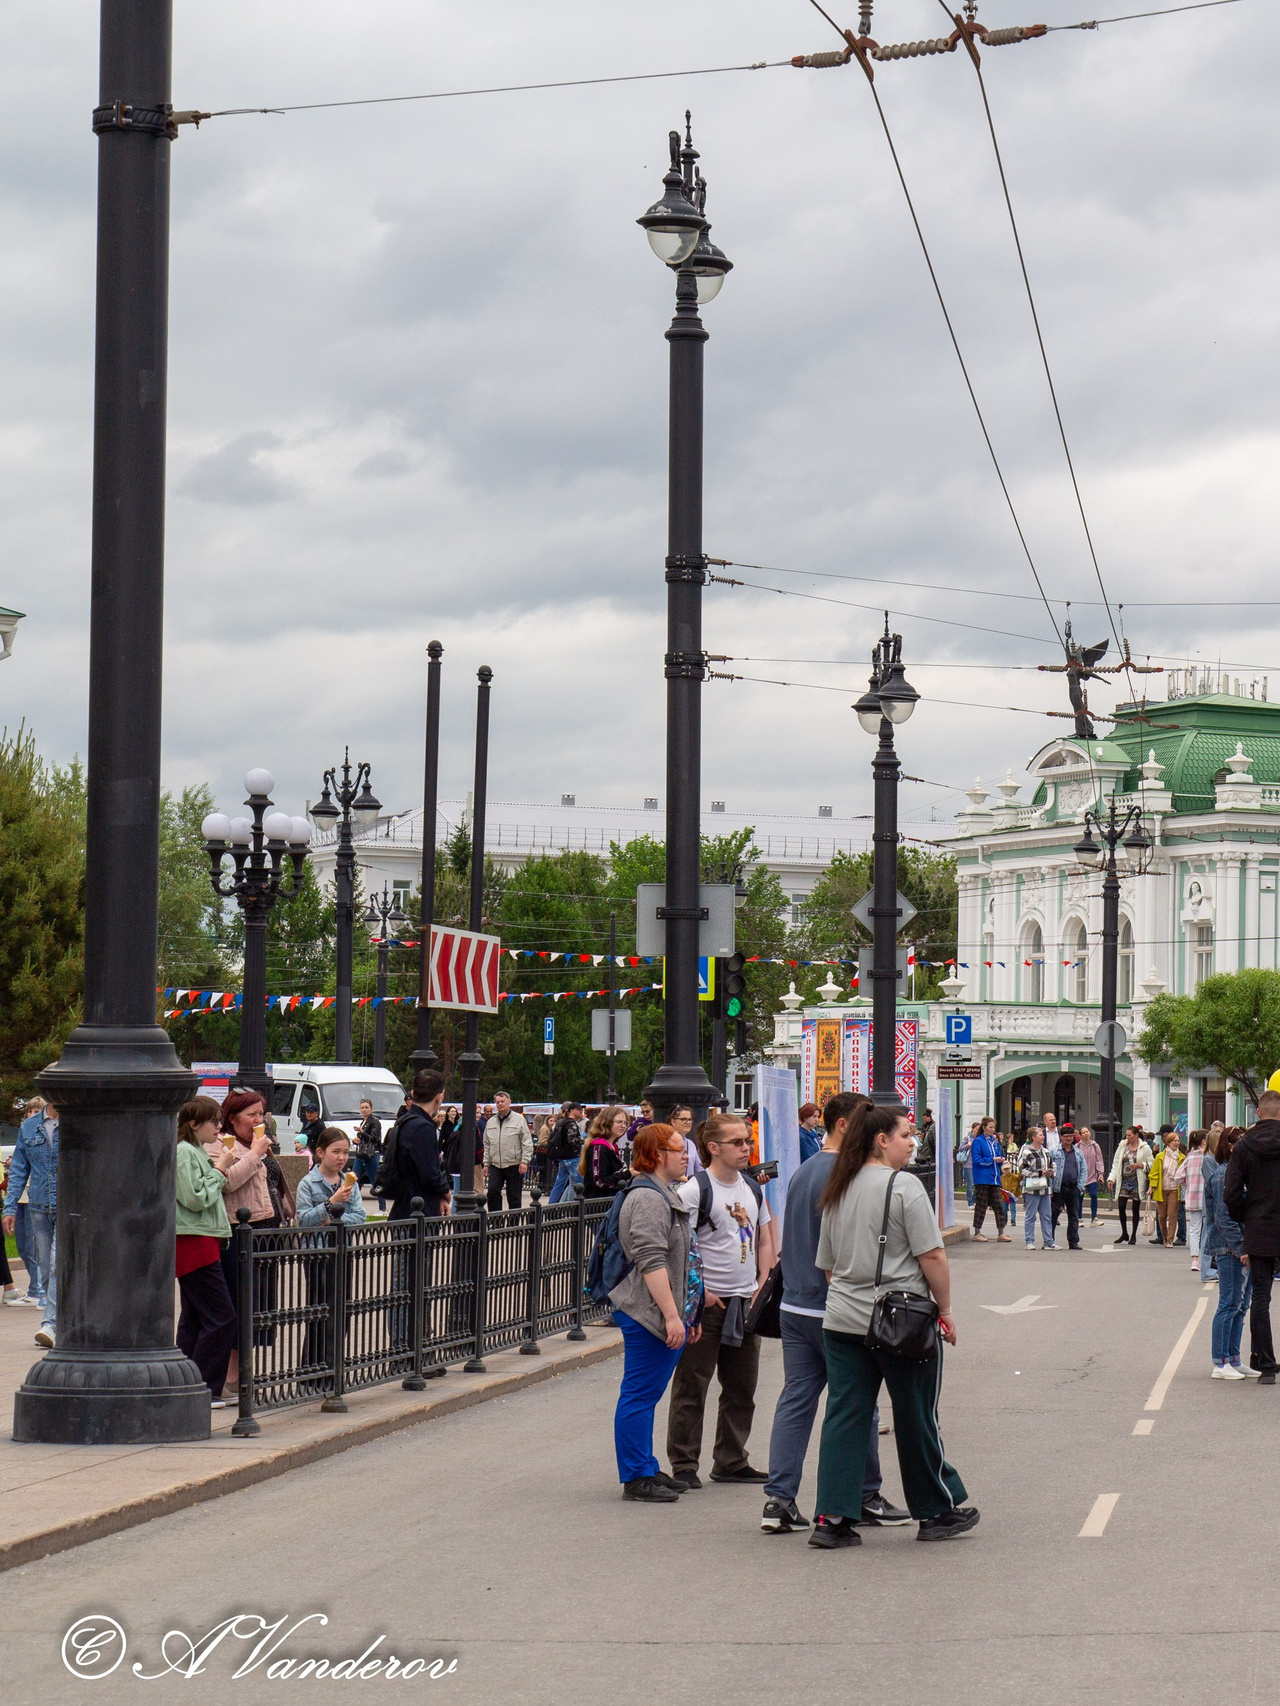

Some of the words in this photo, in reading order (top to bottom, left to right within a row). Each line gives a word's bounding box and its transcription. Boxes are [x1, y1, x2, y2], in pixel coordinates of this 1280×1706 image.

[546, 1020, 553, 1039] P
[951, 1018, 967, 1042] P
[805, 1030, 813, 1104] СЛАВЯНСКИ
